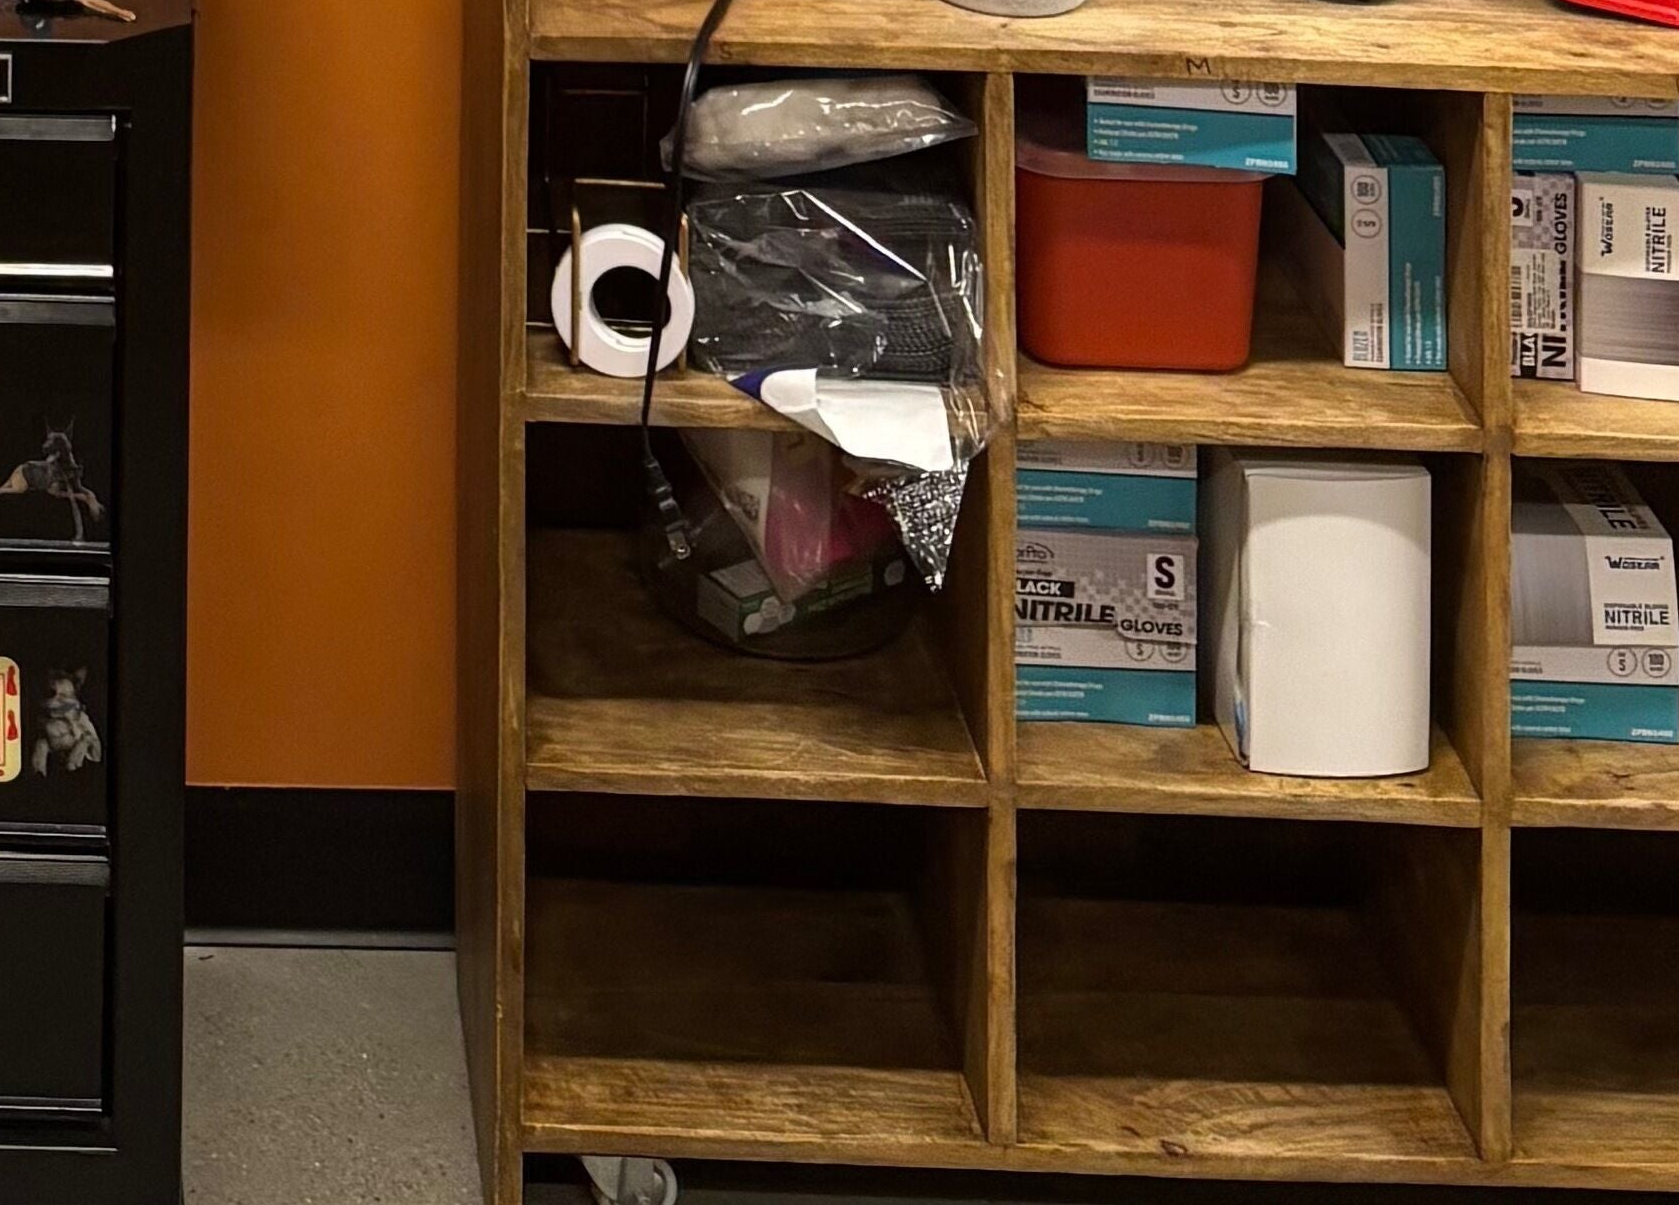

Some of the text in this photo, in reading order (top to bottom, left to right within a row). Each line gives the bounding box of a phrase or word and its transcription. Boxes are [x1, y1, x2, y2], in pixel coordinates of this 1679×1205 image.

[1553, 192, 1568, 255] GLOVES
[1651, 206, 1667, 274] NITRILE
[1154, 555, 1176, 589] S
[1015, 581, 1062, 596] LACK
[1120, 618, 1184, 636] GLOVES
[1604, 610, 1670, 625] NITRILE
